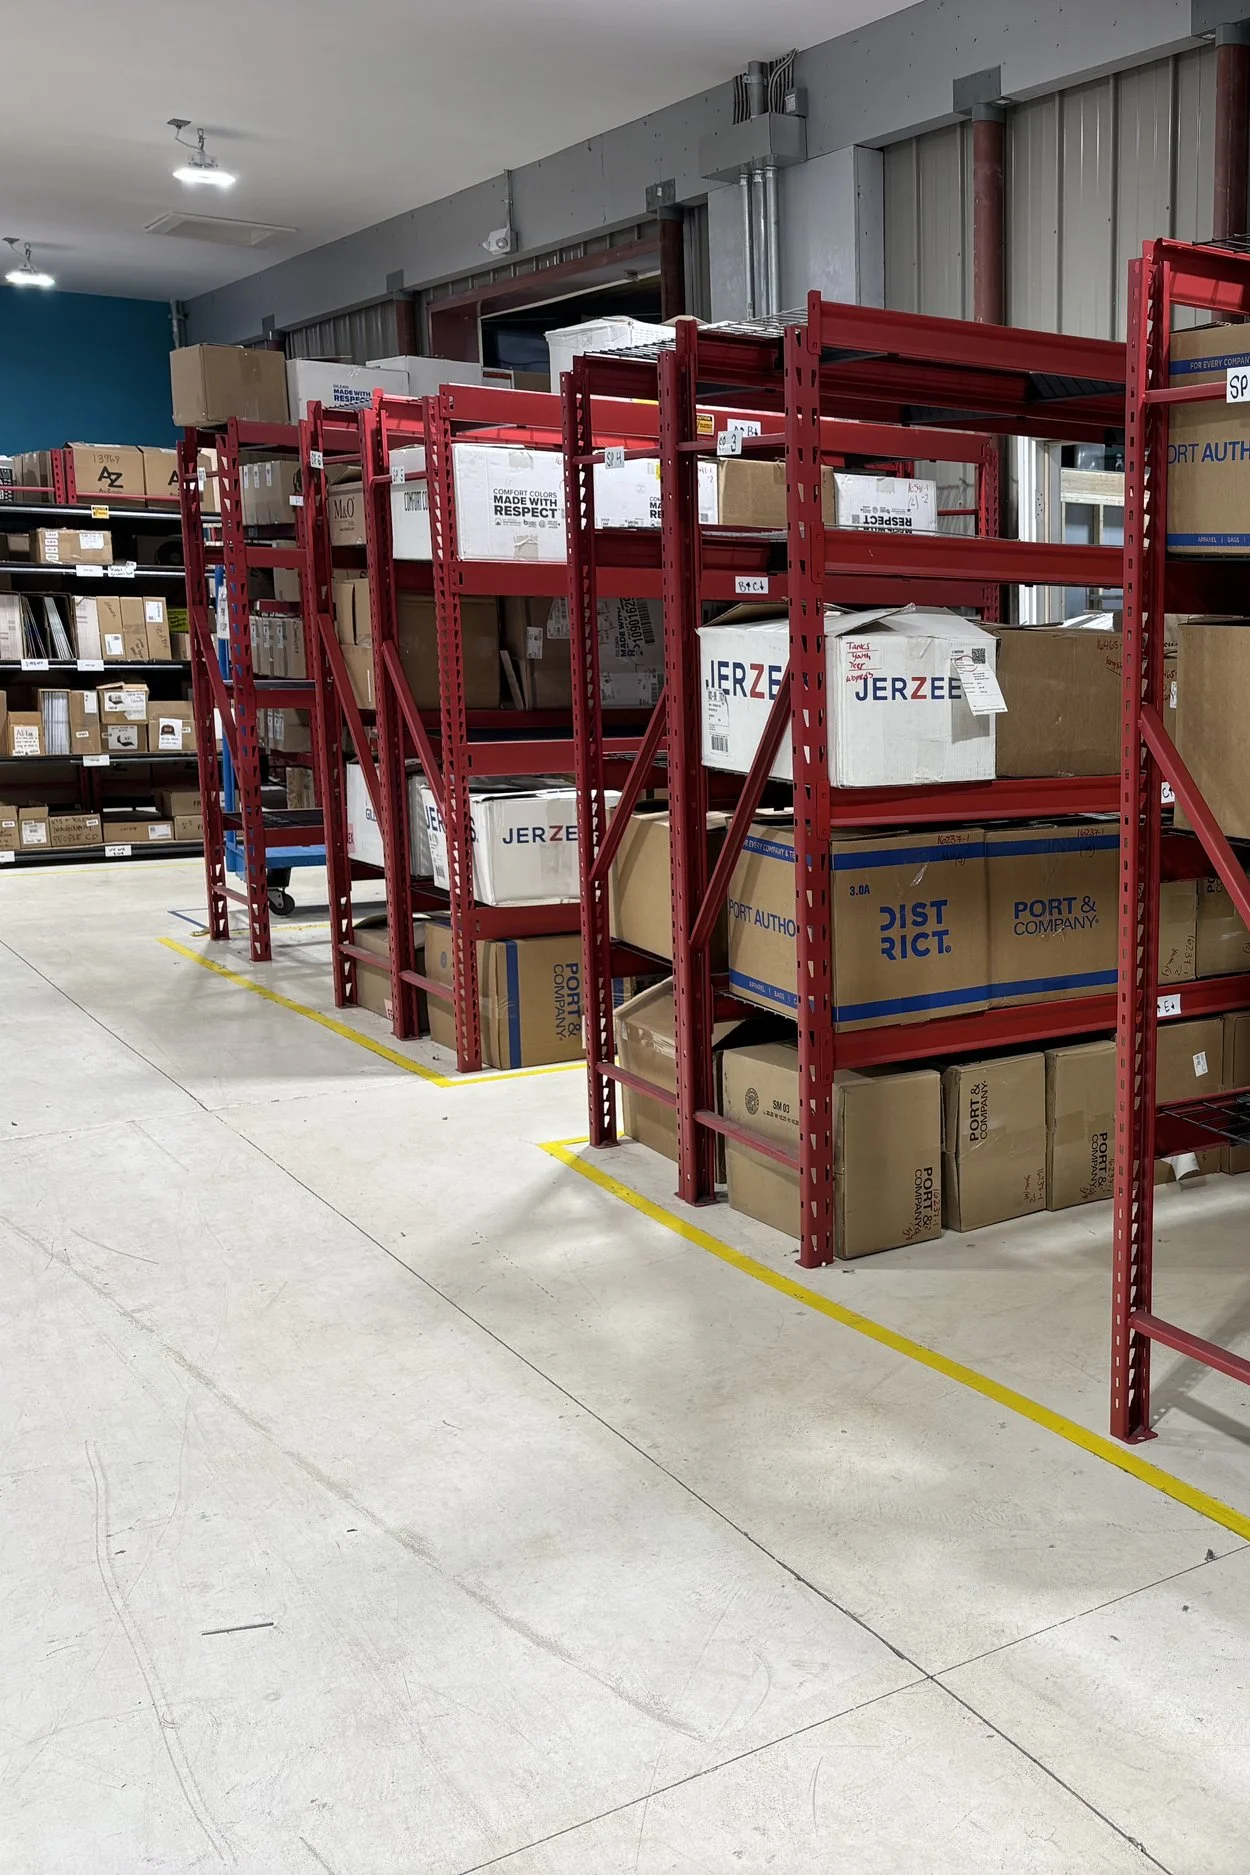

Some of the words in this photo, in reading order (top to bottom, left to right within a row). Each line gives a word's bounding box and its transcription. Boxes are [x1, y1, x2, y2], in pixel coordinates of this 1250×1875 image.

[1190, 361, 1202, 370] FOR
[1203, 358, 1222, 369] EVERY
[333, 388, 353, 396] MADE
[353, 390, 371, 398] WITH
[1228, 375, 1249, 399] SP
[730, 434, 737, 452] 3
[1166, 443, 1199, 464] ORT
[606, 451, 615, 467] SP
[98, 466, 124, 489] AZ
[493, 488, 528, 497] COMFORT
[529, 490, 558, 499] COLORS
[493, 495, 527, 506] MADE
[528, 497, 558, 508] WITH
[334, 498, 355, 520] M&O
[494, 505, 558, 519] RESPECT
[863, 514, 912, 527] RESPECT
[855, 676, 967, 701] JERZEE
[849, 884, 871, 897] 3.0A
[729, 899, 753, 923] PORT
[754, 909, 797, 938] AUTHO
[880, 900, 948, 932] DIST
[1013, 897, 1077, 921] PORT
[1081, 896, 1098, 913] &
[1013, 915, 1096, 936] COMPANY
[564, 962, 580, 1018] PORT
[553, 964, 566, 1039] COMPANY
[568, 1023, 582, 1037] &
[970, 1082, 981, 1095] &
[772, 1100, 782, 1111] SM
[782, 1103, 790, 1114] 03
[969, 1098, 979, 1142] PORT
[1090, 1133, 1099, 1189] COMPANY
[1098, 1132, 1108, 1174] PORT
[914, 1168, 923, 1228] COMPANY
[923, 1166, 933, 1212] PORT
